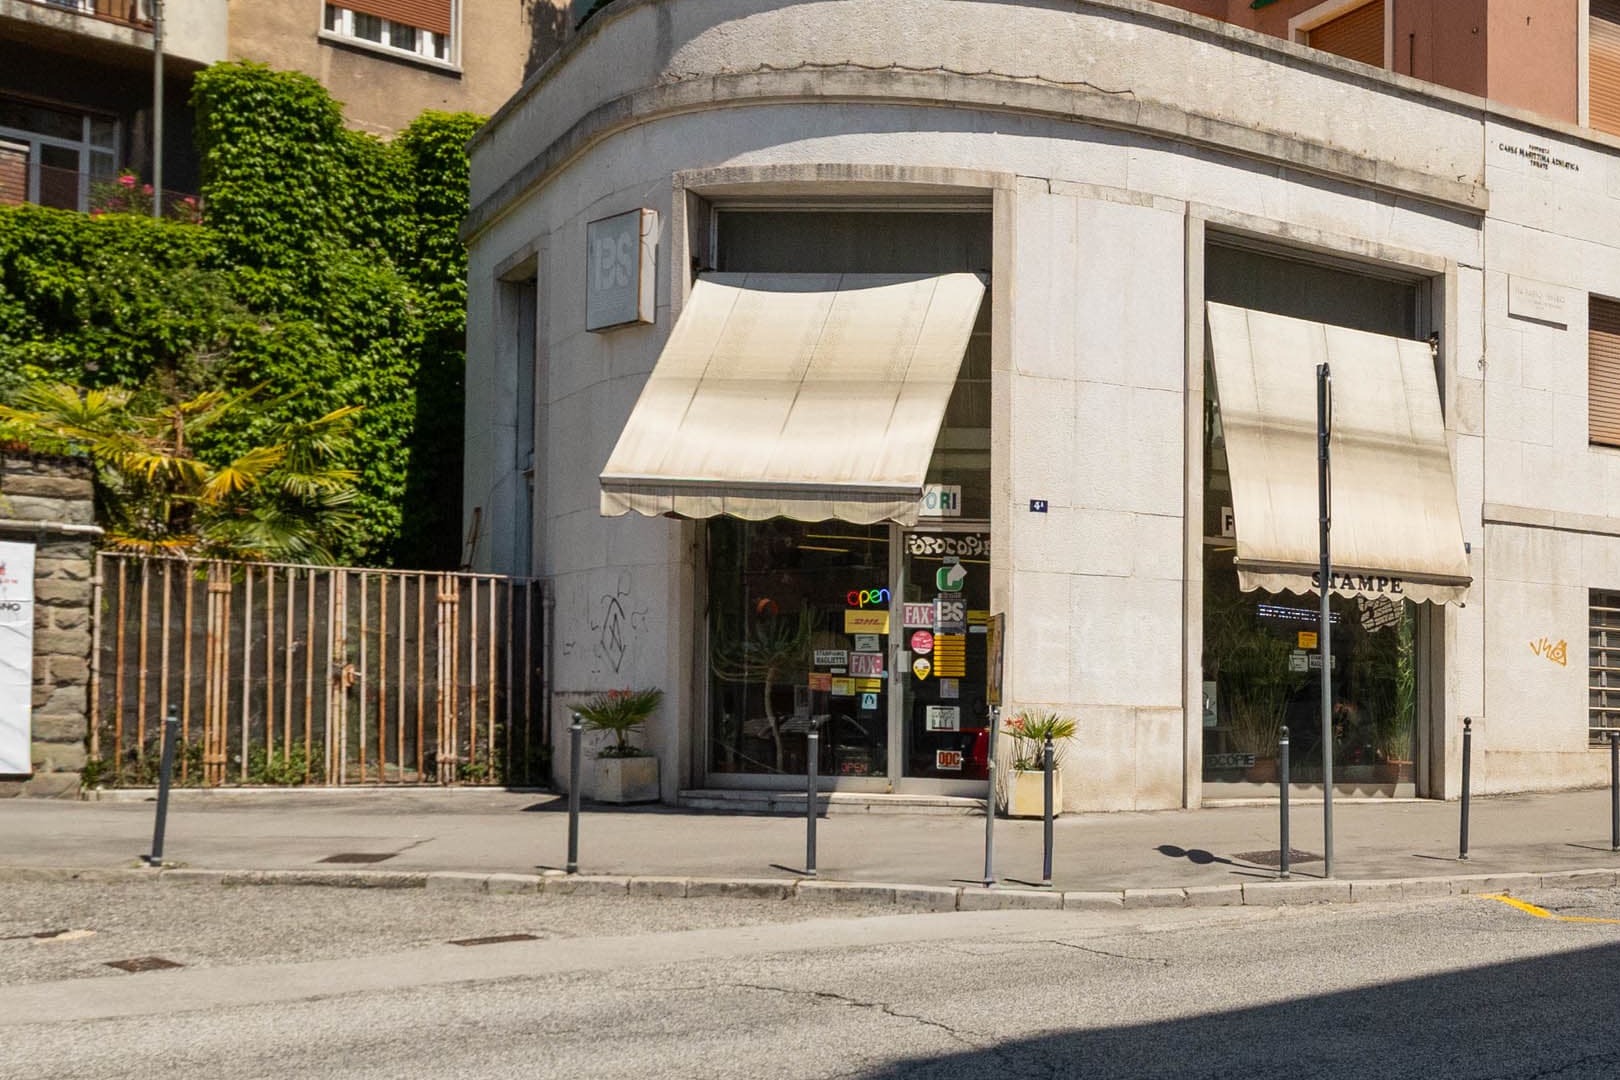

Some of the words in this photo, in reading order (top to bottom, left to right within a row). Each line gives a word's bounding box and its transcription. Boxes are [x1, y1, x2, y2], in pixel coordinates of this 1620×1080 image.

[925, 491, 957, 510] ORI
[1311, 571, 1404, 594] STAMPE
[847, 588, 890, 608] open
